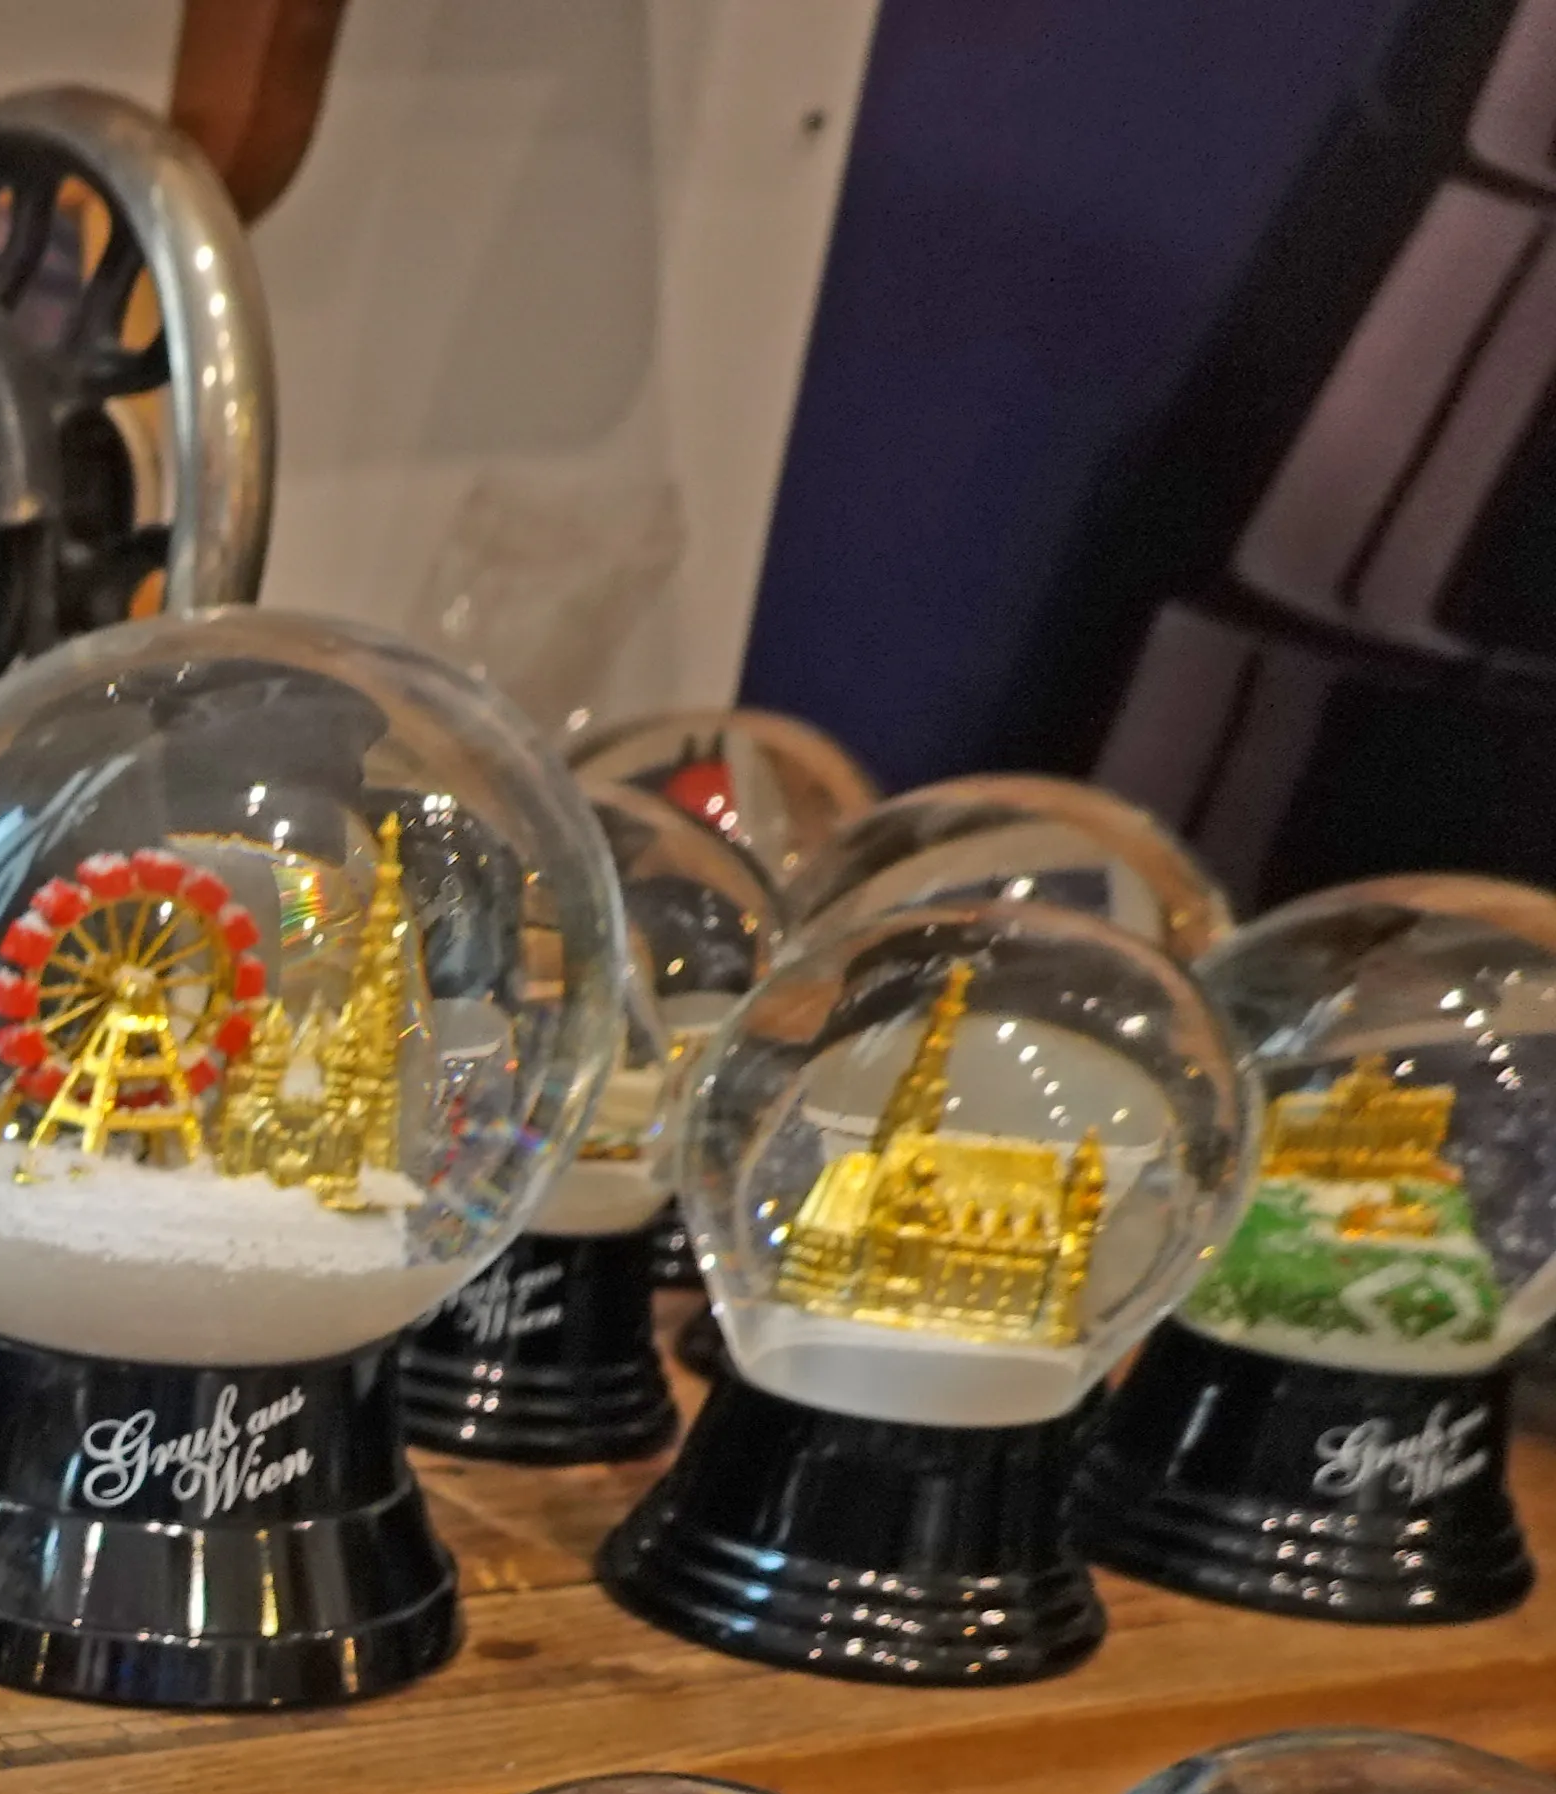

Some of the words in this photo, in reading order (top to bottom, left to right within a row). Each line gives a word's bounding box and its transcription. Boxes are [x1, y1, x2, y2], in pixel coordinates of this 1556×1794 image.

[82, 1384, 241, 1508] Gruß
[246, 1385, 306, 1436] aus
[172, 1433, 315, 1519] Wien
